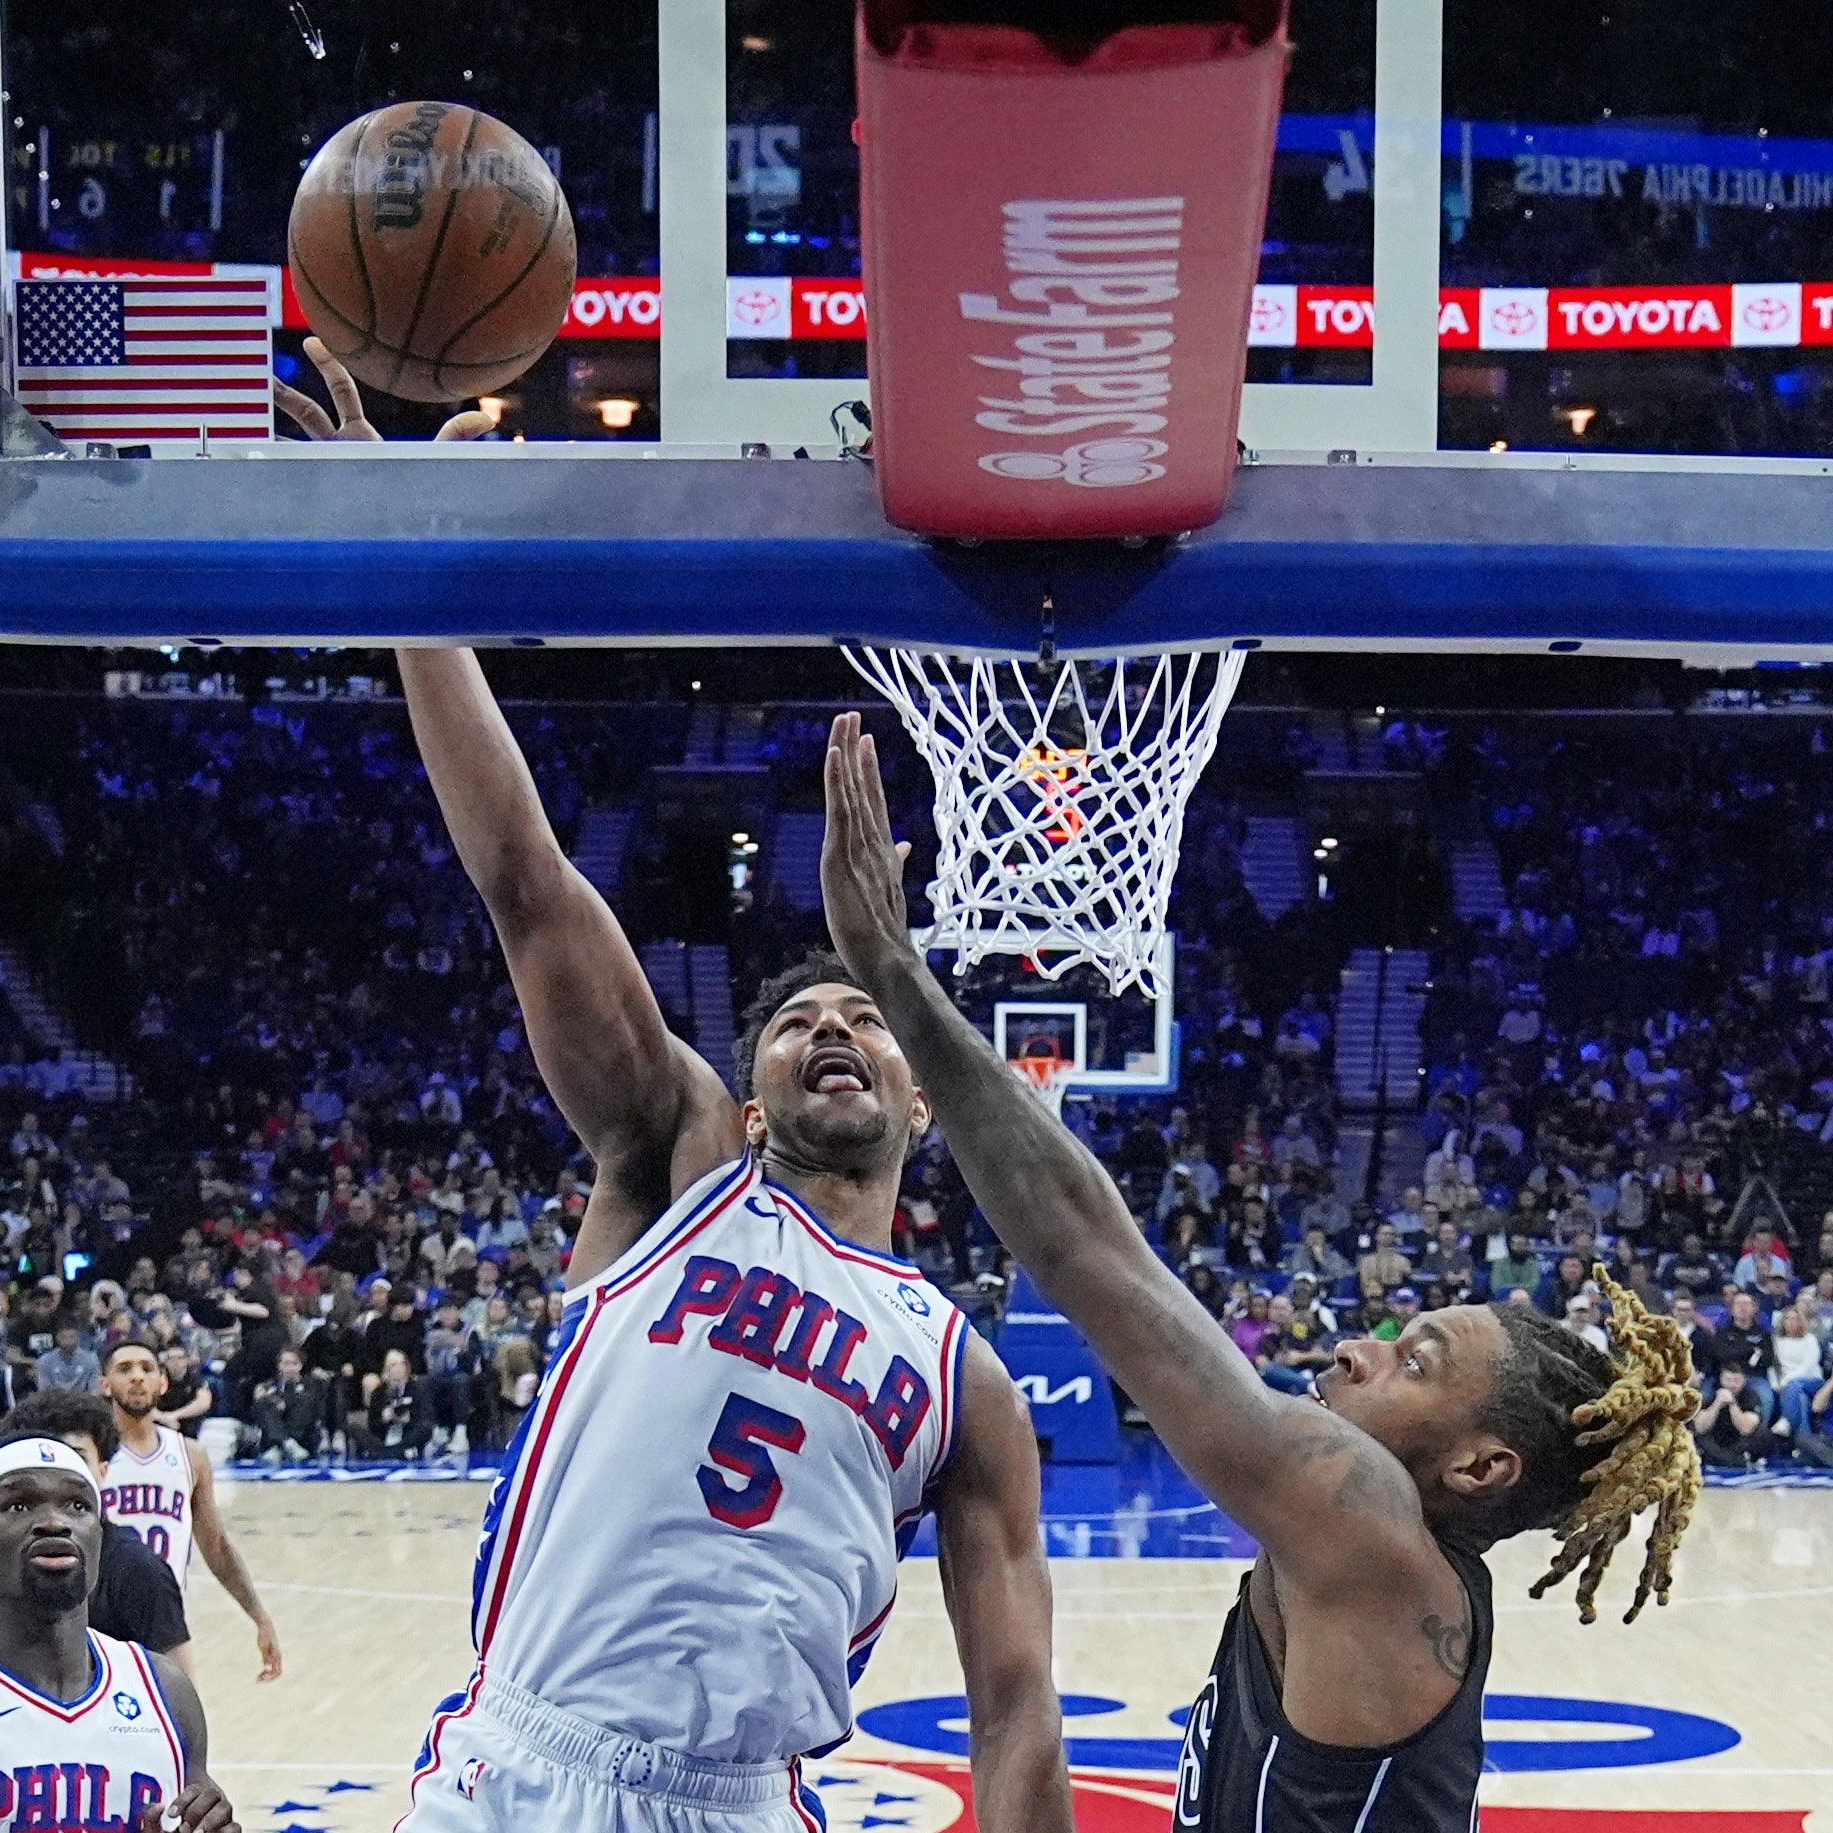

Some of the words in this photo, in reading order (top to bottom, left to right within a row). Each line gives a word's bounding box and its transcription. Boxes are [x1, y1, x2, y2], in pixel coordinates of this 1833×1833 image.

[1559, 301, 1722, 345] TOYOTA
[877, 1289, 938, 1345] crypto.com
[648, 1255, 930, 1472] PHILA
[695, 1392, 807, 1530] 5
[99, 1484, 185, 1523] PHILA
[108, 1724, 161, 1735] crypto.com
